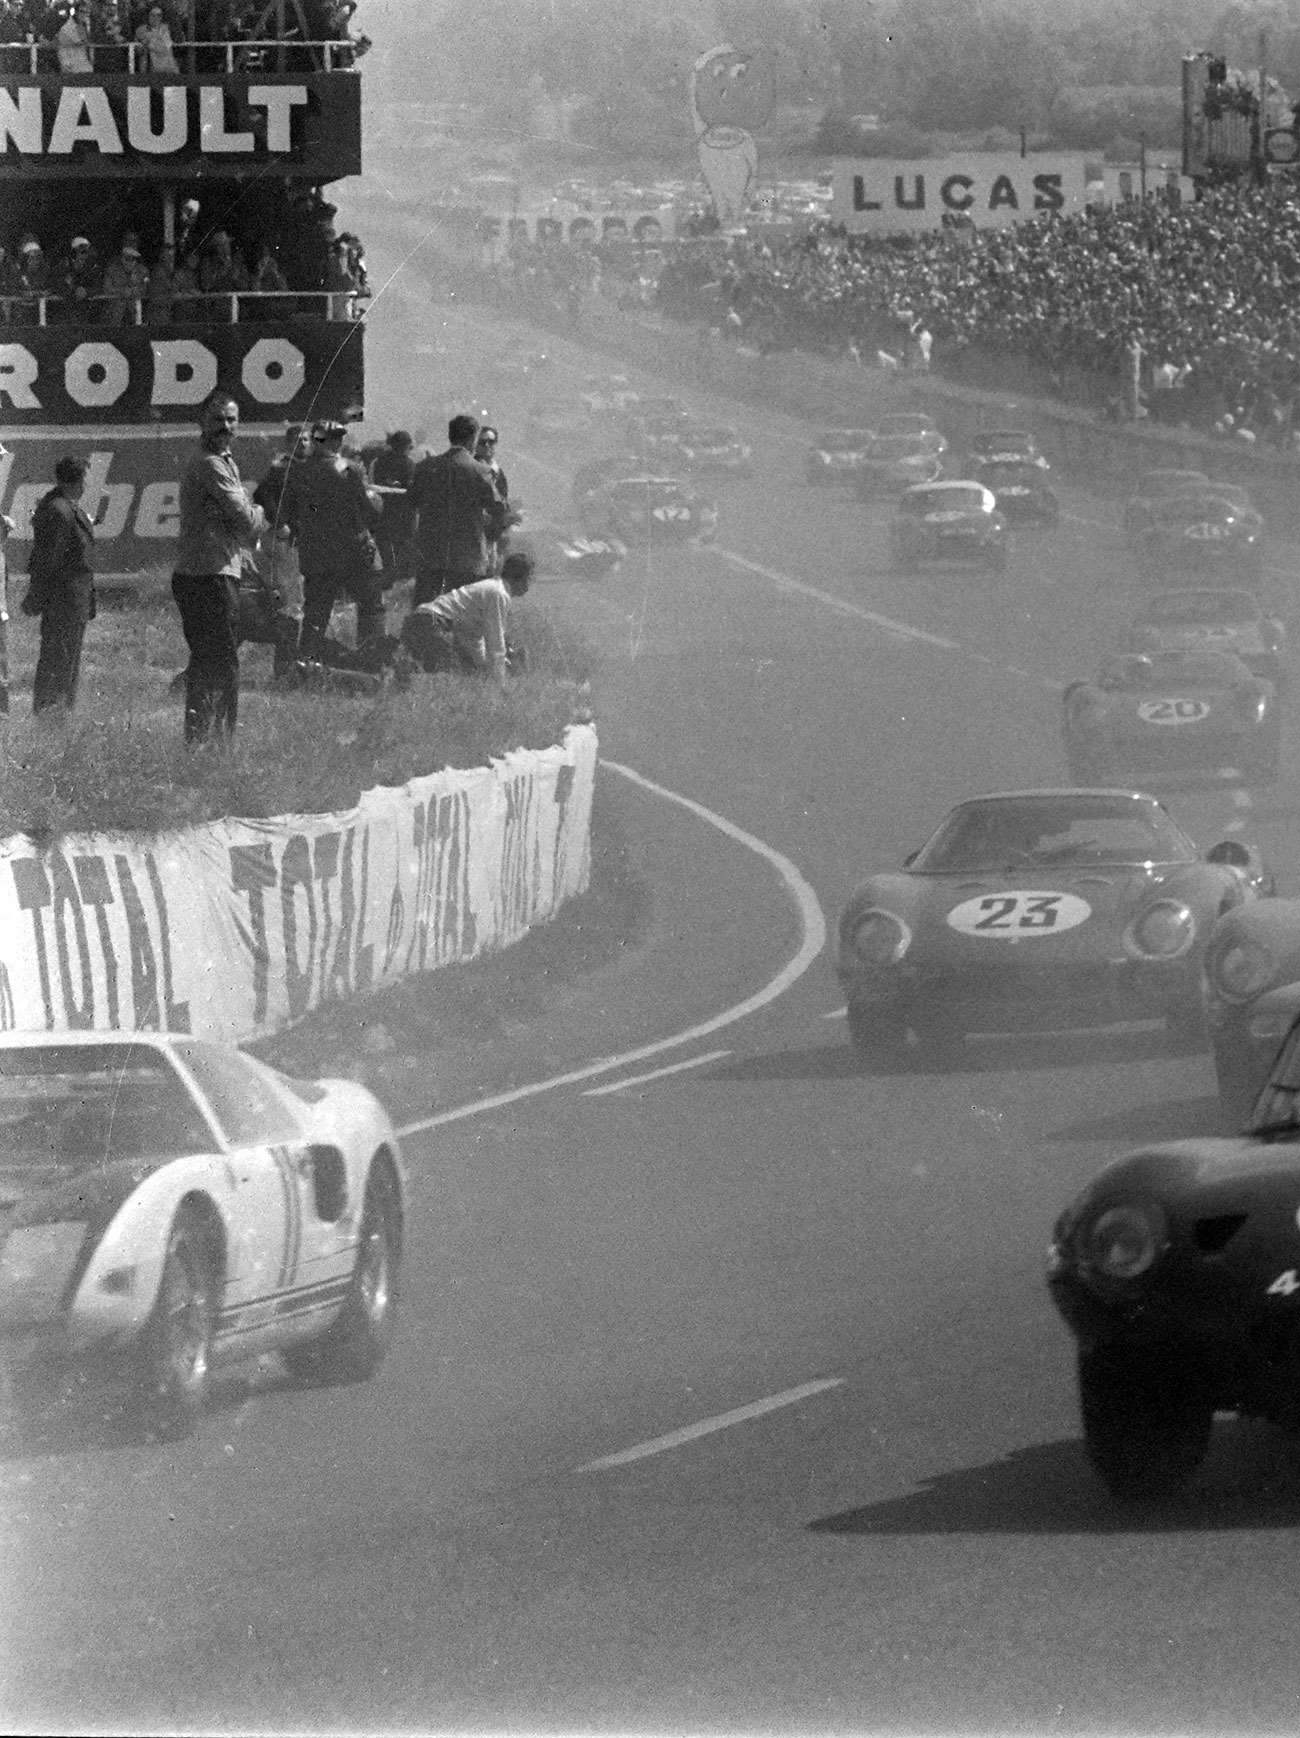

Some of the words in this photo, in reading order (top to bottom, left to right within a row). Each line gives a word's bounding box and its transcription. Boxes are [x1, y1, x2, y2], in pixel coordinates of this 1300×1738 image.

[0, 86, 307, 153] NAULT
[853, 174, 1065, 211] LUCAS
[0, 338, 305, 408] RODO
[1146, 701, 1202, 718] 20
[975, 896, 1062, 930] 23
